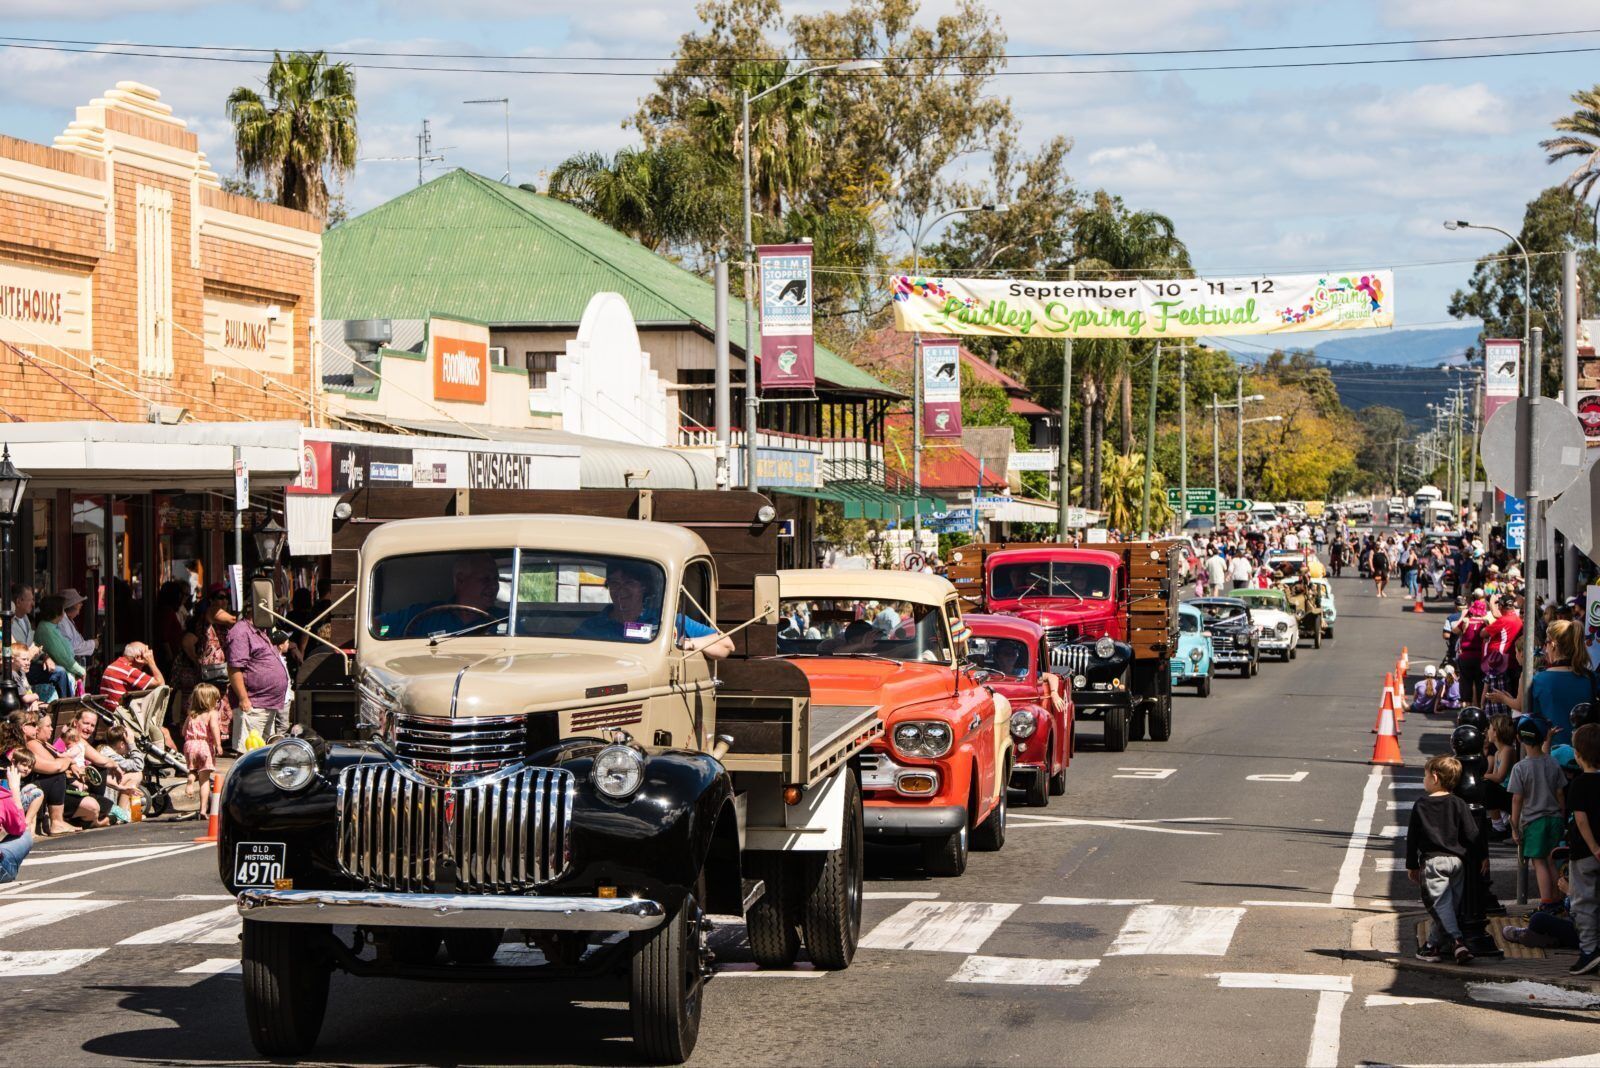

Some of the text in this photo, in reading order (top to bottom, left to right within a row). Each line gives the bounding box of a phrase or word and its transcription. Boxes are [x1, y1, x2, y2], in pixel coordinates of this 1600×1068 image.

[765, 258, 808, 269] CRIME
[765, 270, 808, 279] STOPPERS
[1009, 283, 1137, 300] September
[1155, 283, 1181, 297] 10
[1207, 282, 1225, 296] 11
[1251, 280, 1275, 295] 12
[1314, 286, 1371, 310] Spring
[0, 285, 61, 322] ITEHOUSE
[1044, 300, 1147, 336] Spring
[1151, 297, 1260, 333] Festival
[226, 319, 266, 350] BUILDINGS
[468, 452, 531, 489] NEWSAGENT
[244, 853, 276, 862] HISTORIC
[252, 845, 269, 854] QLD
[237, 861, 282, 884] 4970
